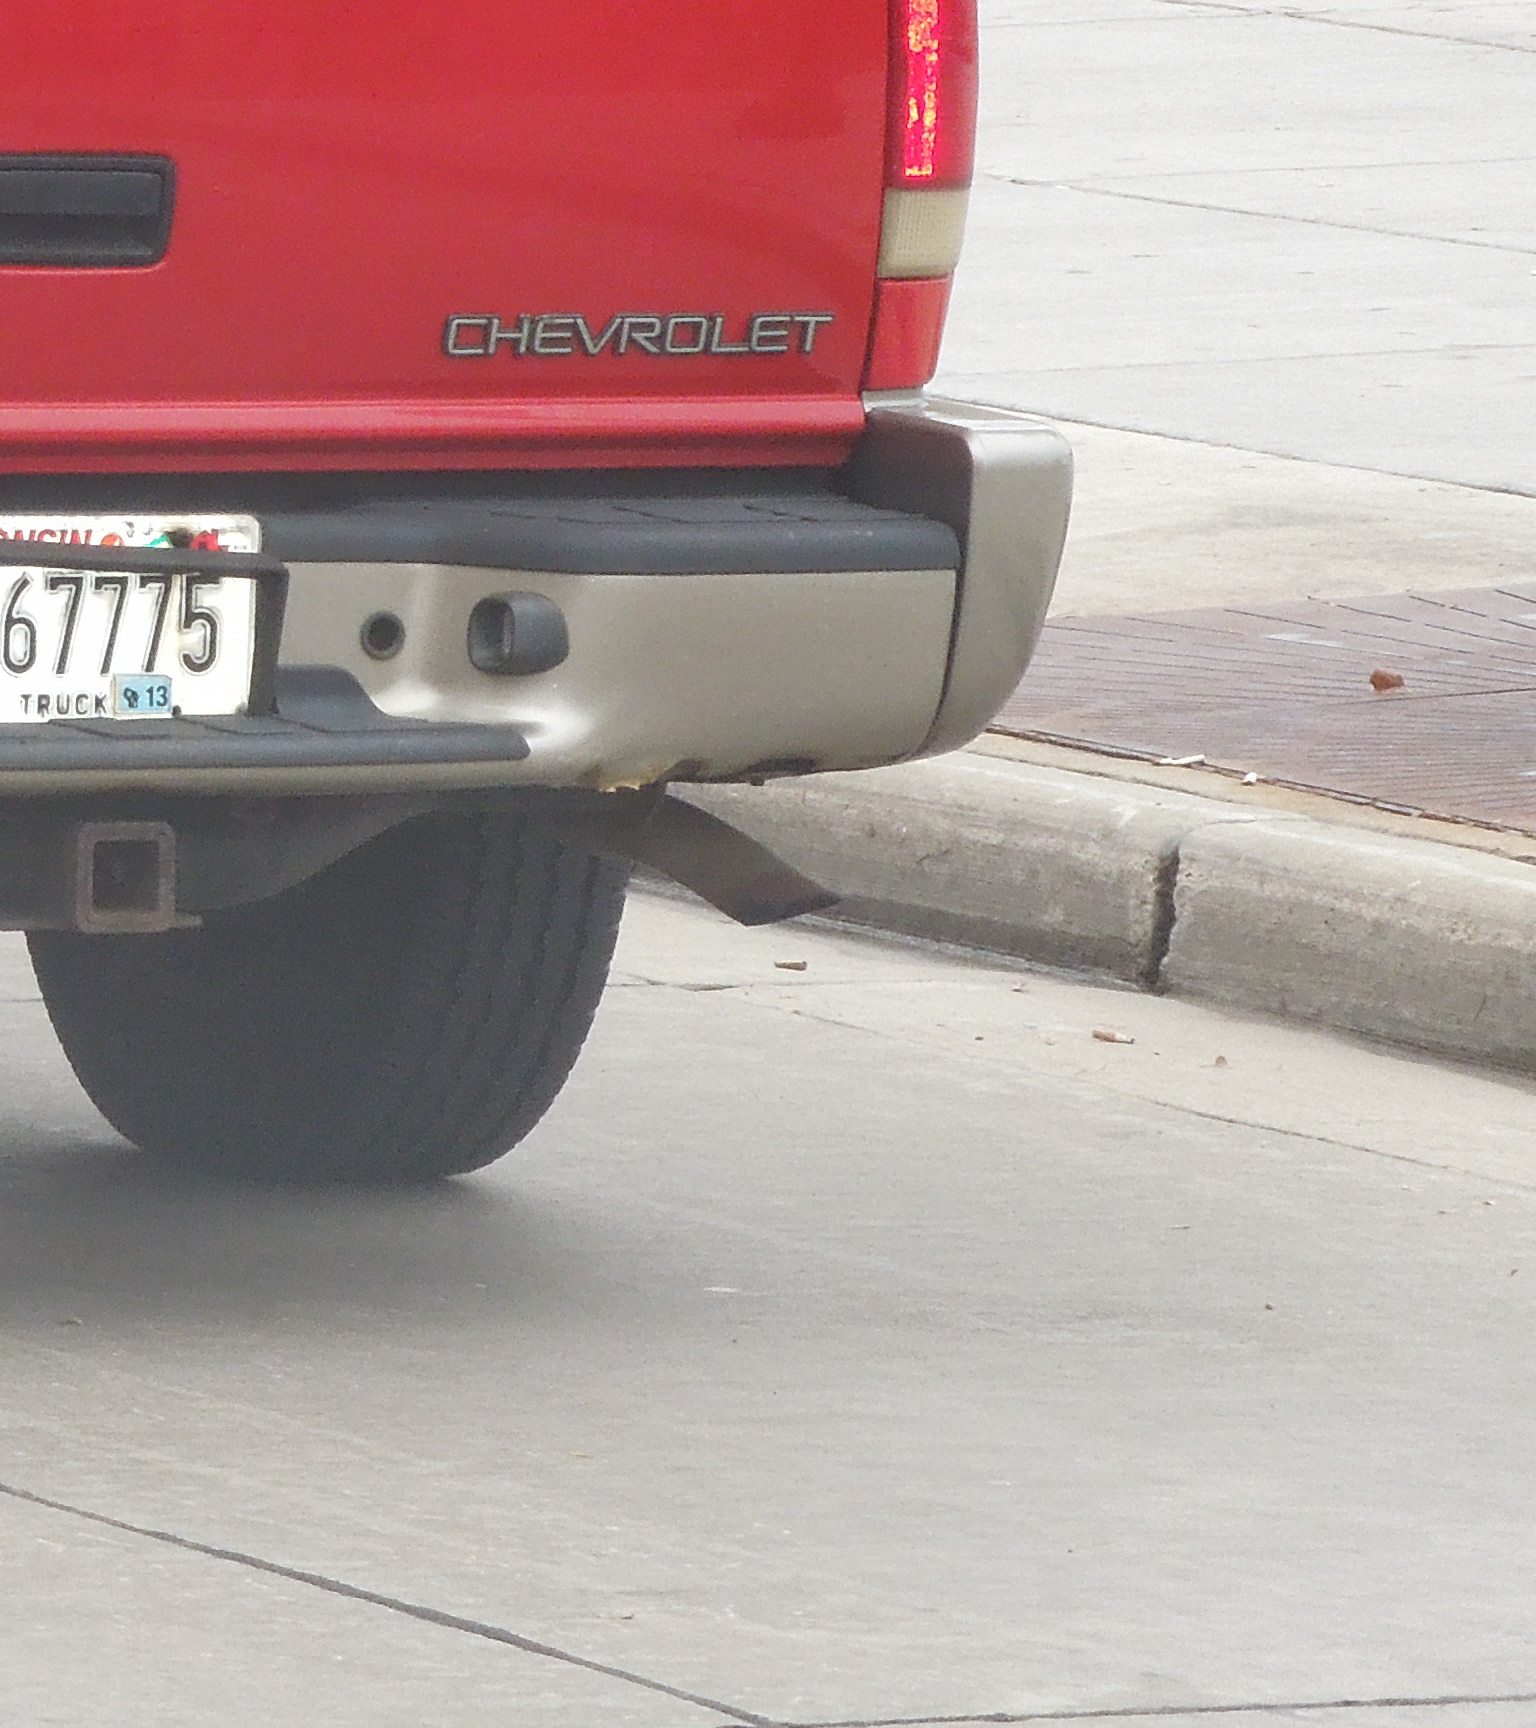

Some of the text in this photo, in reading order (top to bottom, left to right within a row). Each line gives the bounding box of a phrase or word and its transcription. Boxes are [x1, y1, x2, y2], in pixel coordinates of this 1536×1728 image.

[443, 310, 835, 357] CHEVROLET
[19, 693, 109, 716] TRUCK
[145, 685, 169, 708] 13
